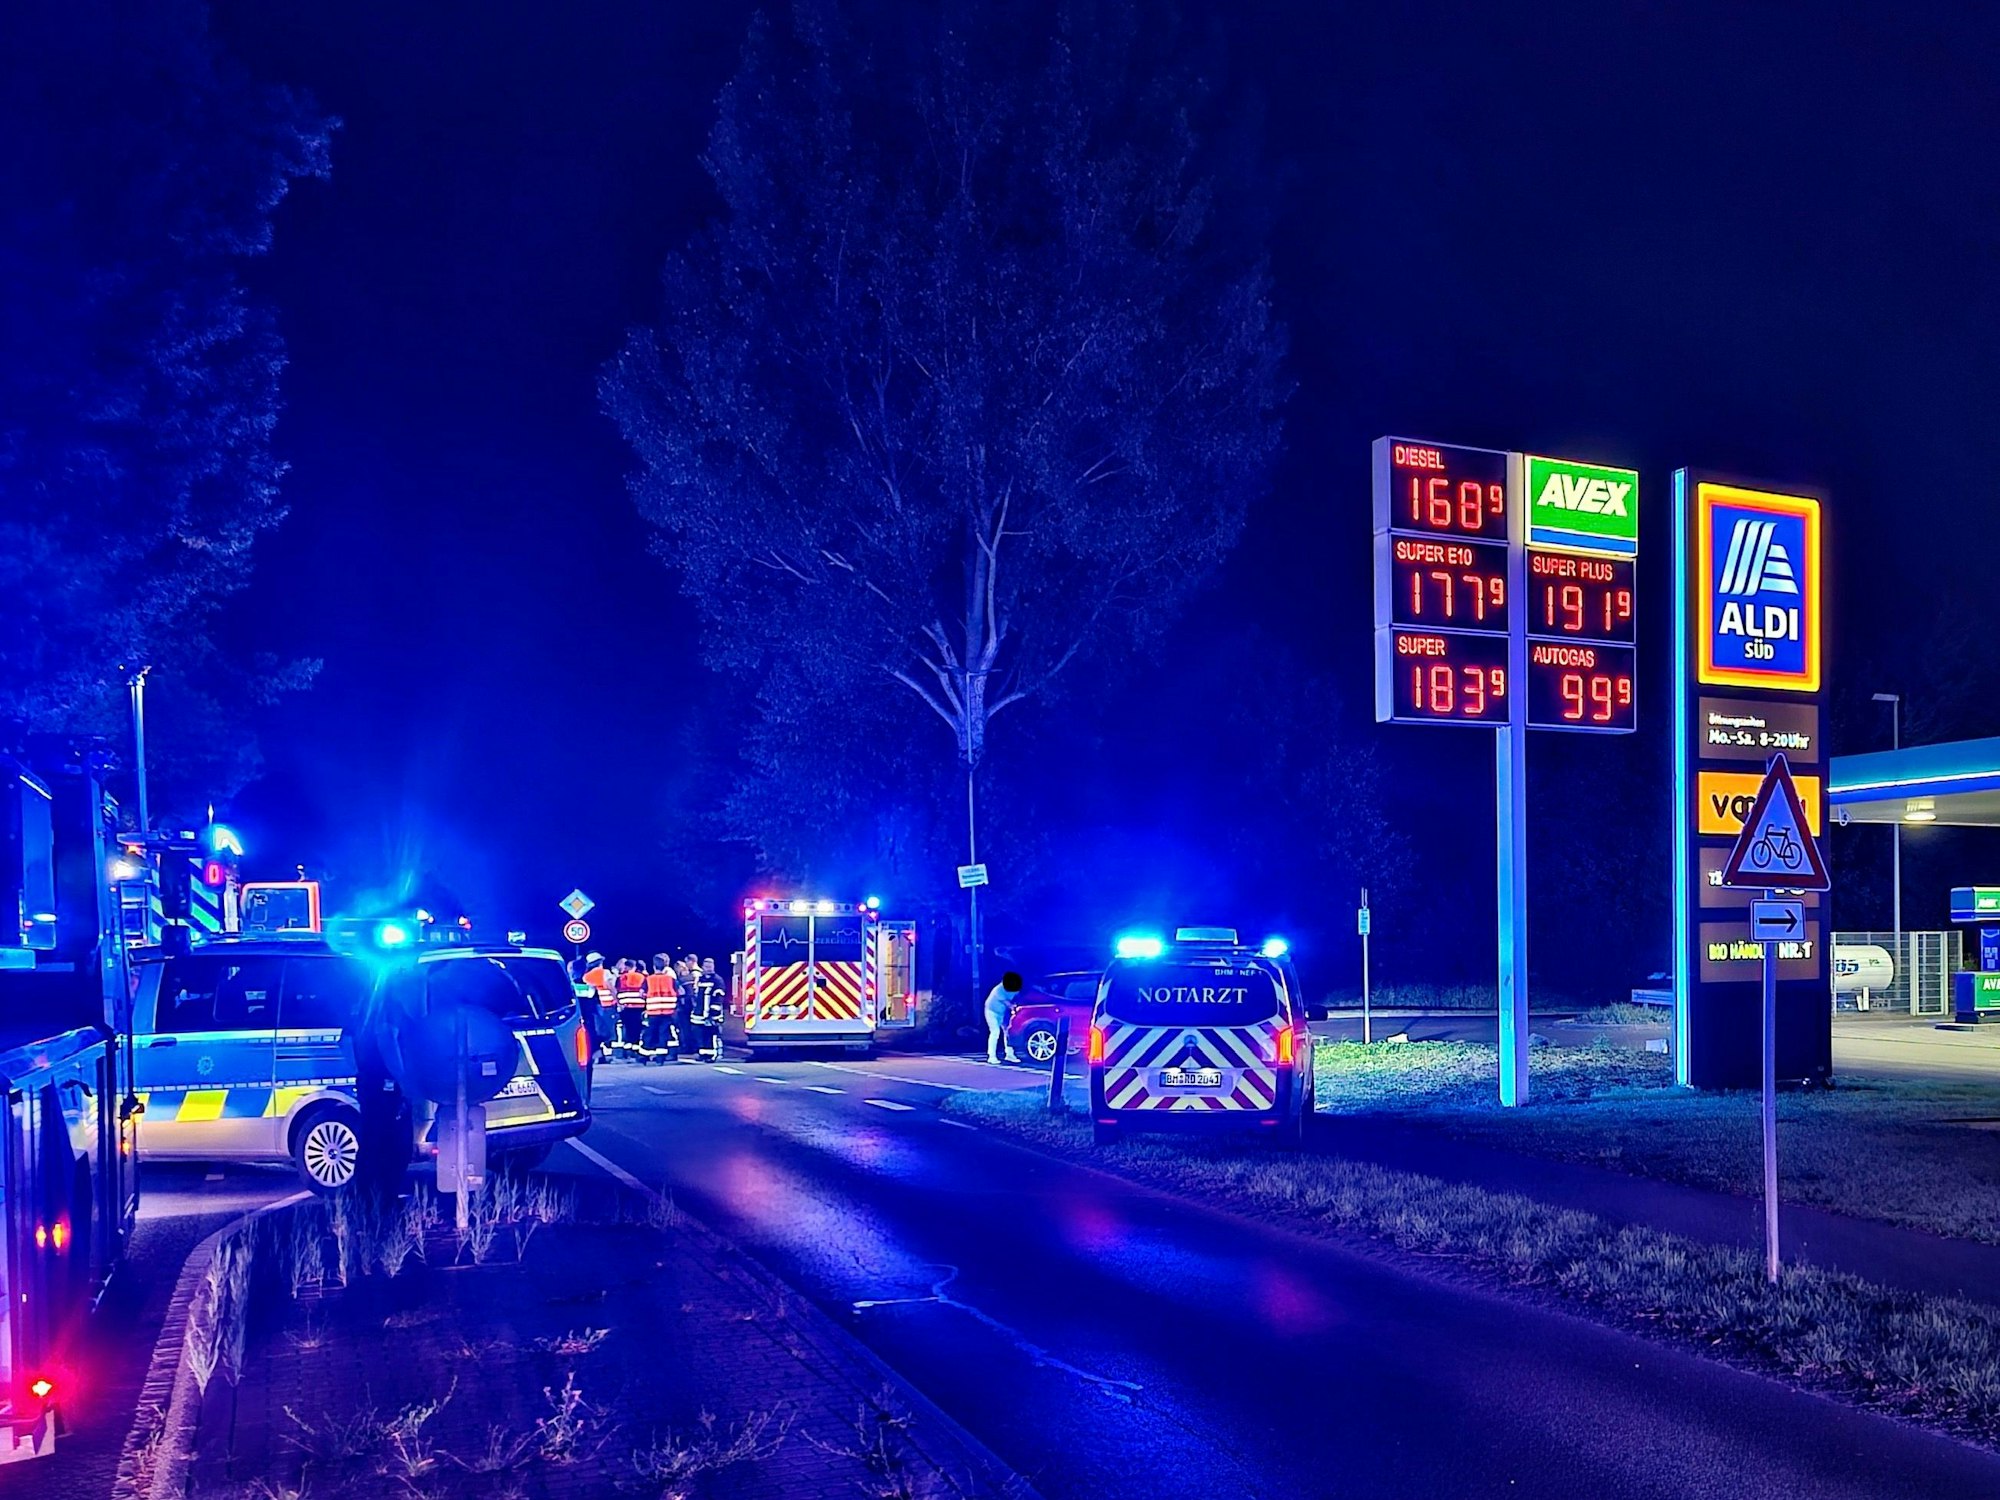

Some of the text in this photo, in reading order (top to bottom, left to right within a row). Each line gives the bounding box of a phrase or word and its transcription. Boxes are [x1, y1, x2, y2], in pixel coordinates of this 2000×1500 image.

[1395, 446, 1445, 470] DIESEL
[1538, 473, 1632, 518] AVEX
[1396, 541, 1473, 566] SUPER E10
[1533, 556, 1613, 581] SUPER PLUS
[1719, 601, 1798, 641] ALDI
[1398, 636, 1446, 656] SUPER
[1533, 646, 1595, 668] AUTOGAS
[1745, 638, 1774, 660] SÜD
[571, 927, 584, 936] 50
[1137, 987, 1248, 1004] NOTARZT
